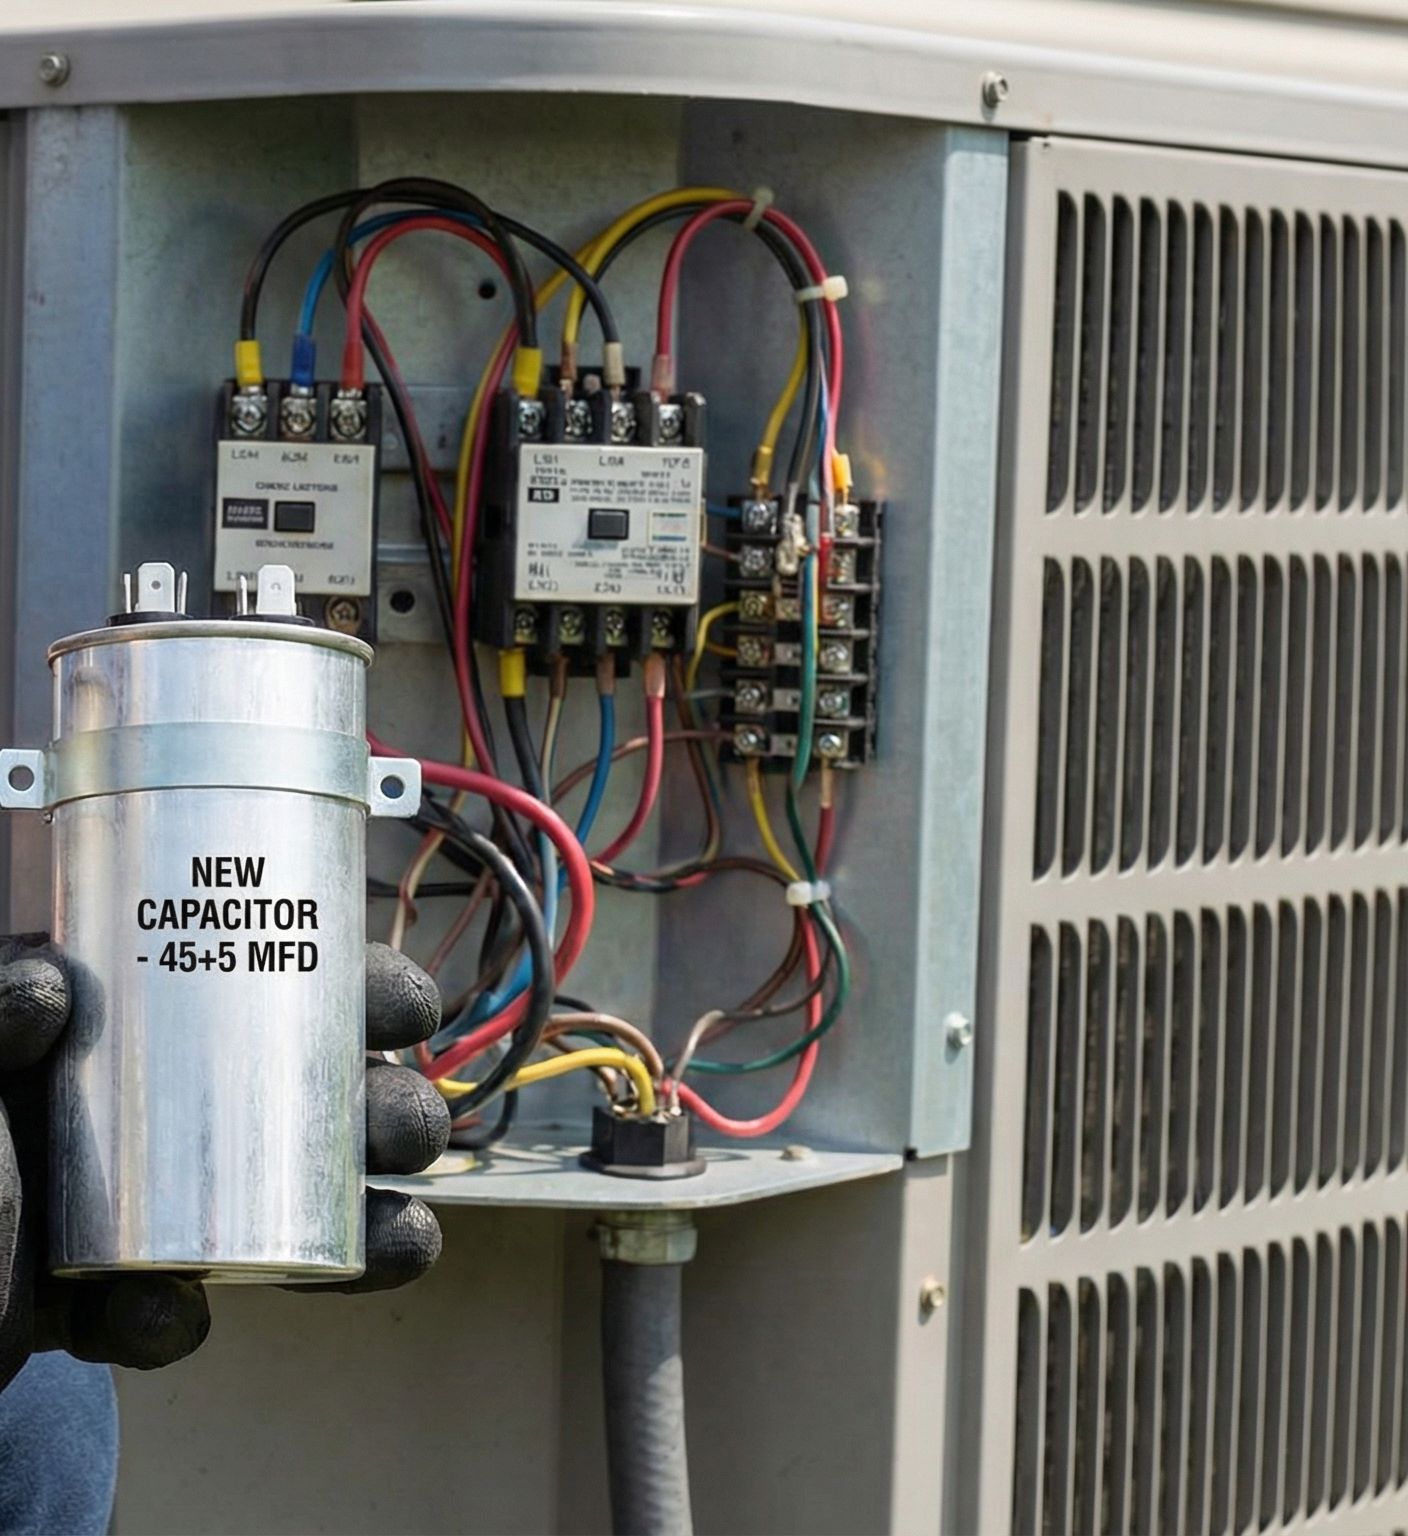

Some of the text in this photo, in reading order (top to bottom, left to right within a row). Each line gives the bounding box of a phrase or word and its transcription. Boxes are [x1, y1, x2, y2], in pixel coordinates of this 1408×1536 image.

[191, 856, 266, 888] NEW
[137, 898, 319, 931] CAPACITOR
[158, 941, 237, 973] 45+5
[247, 941, 319, 973] MFD
